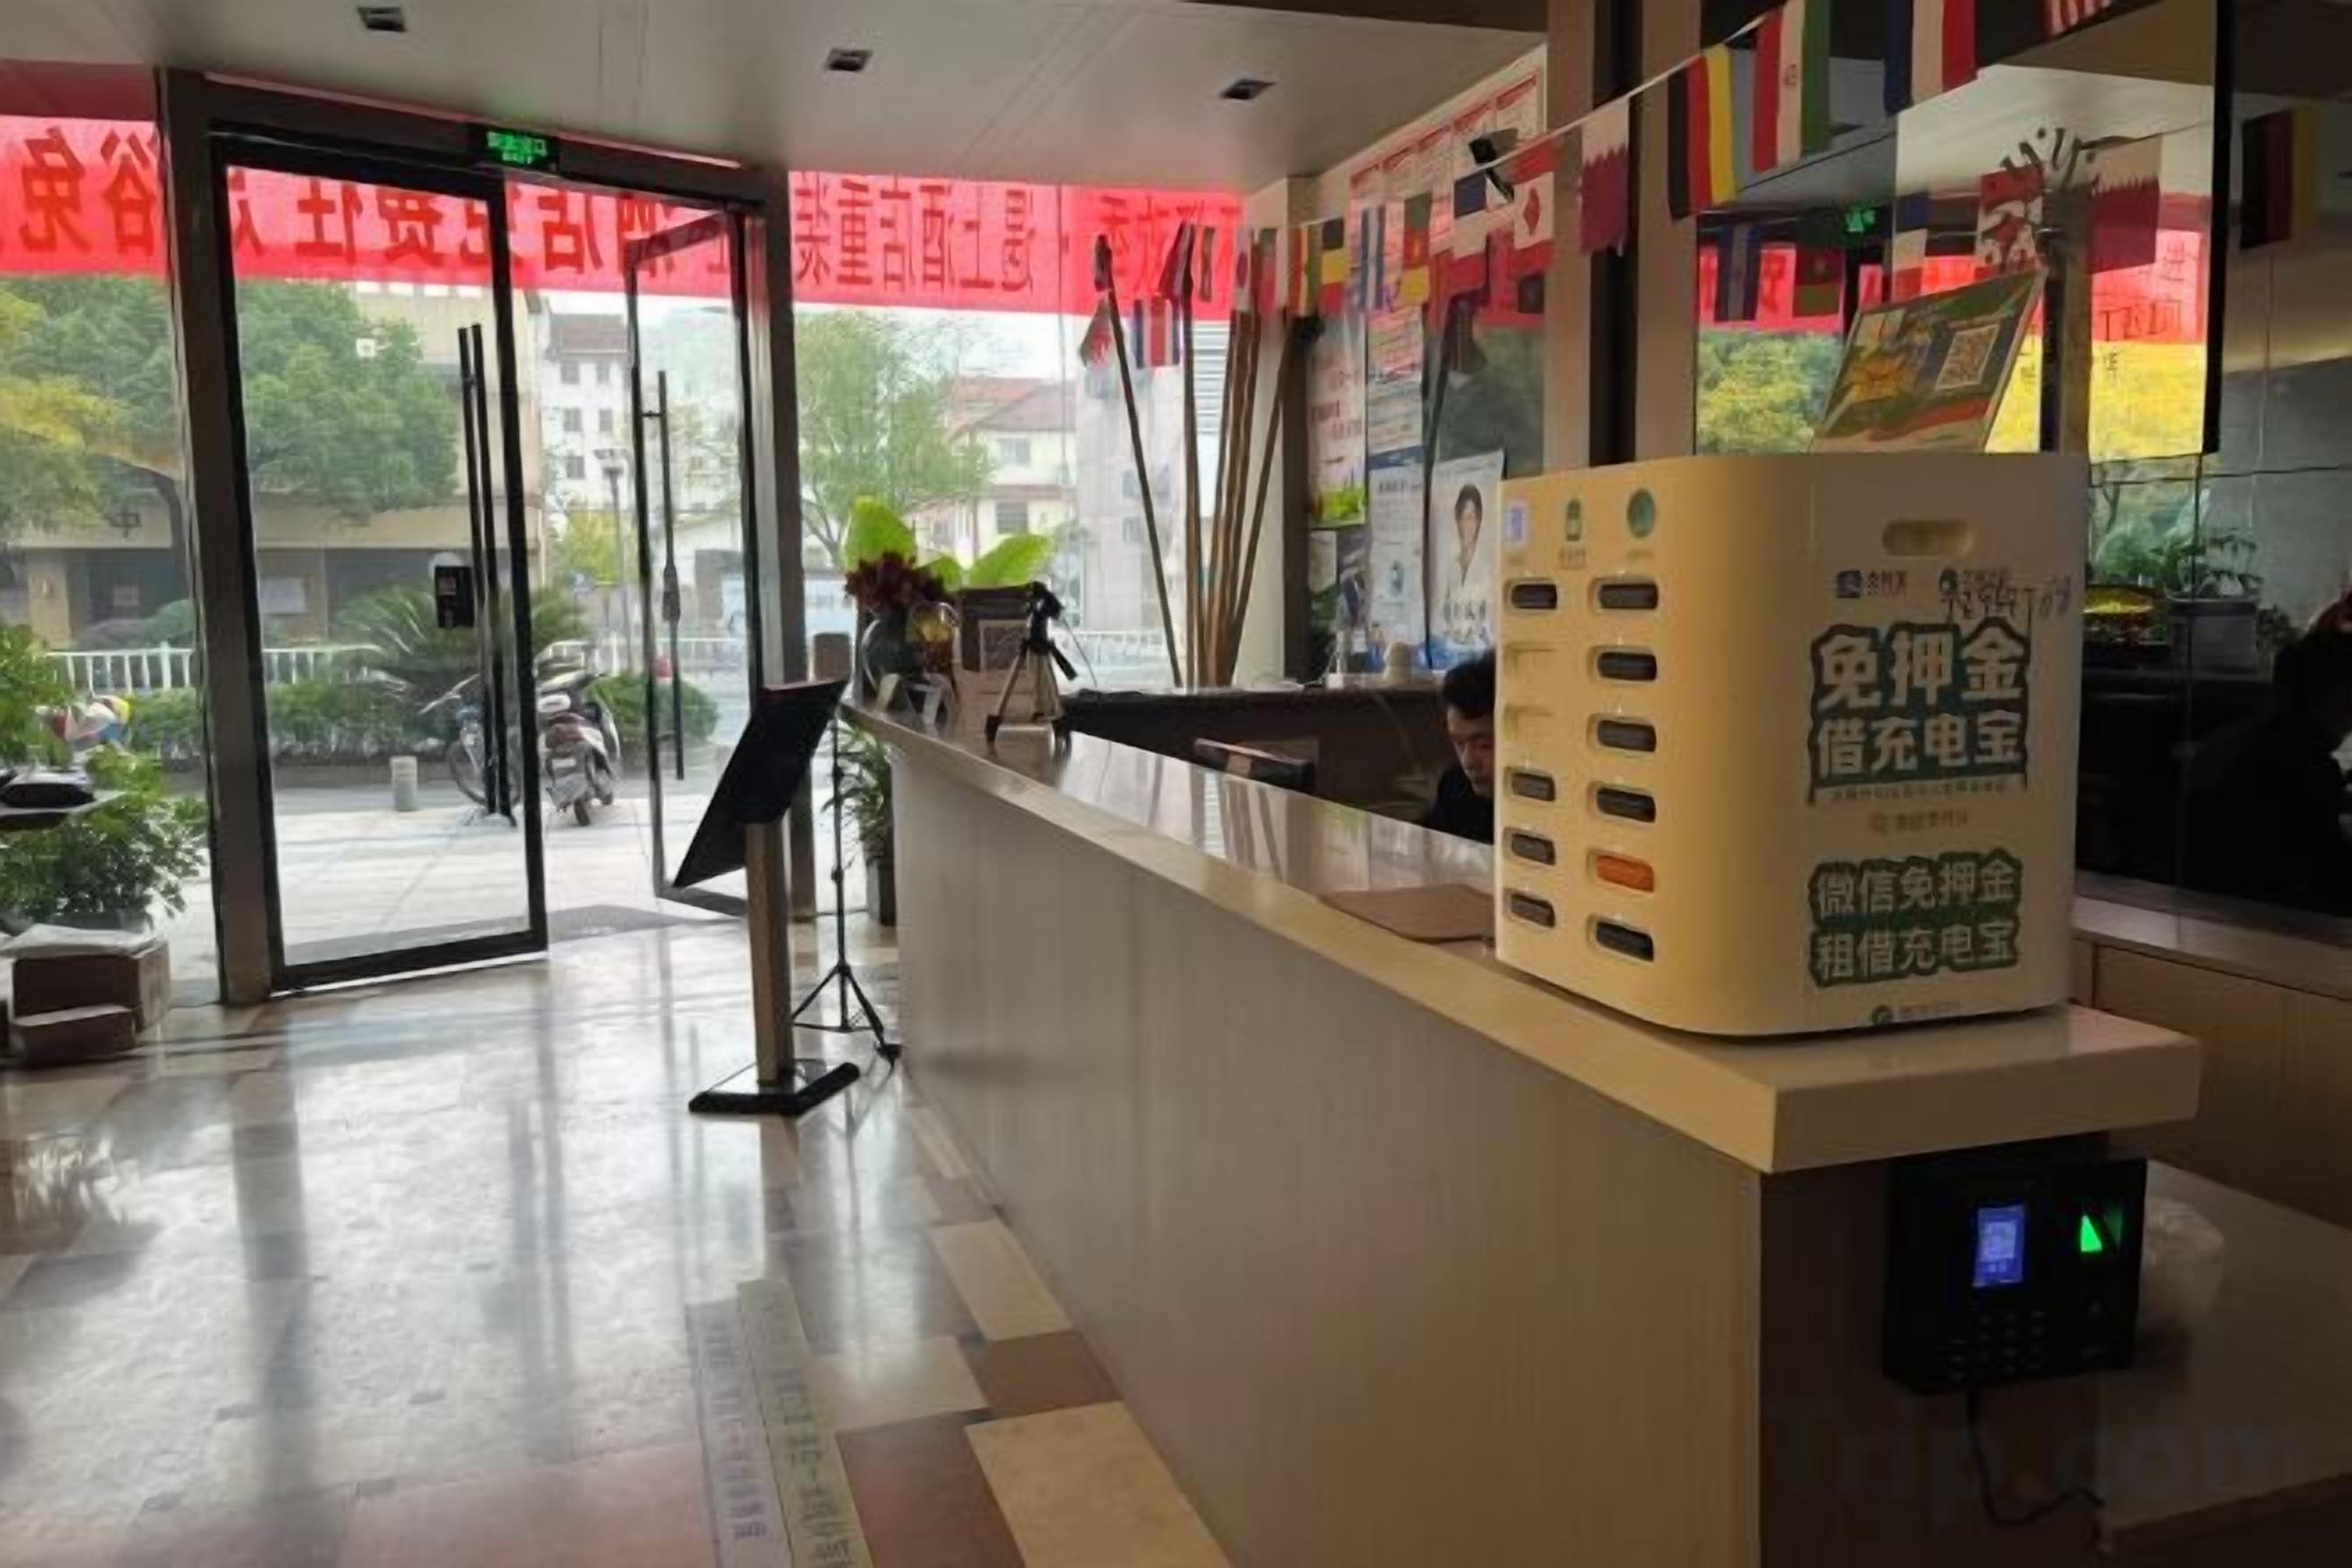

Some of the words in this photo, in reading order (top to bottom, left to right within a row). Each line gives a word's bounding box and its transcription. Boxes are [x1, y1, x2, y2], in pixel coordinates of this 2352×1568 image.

[1816, 625, 2025, 710] 免押金
[1816, 710, 2022, 780] 借充电宝
[1815, 857, 2017, 919] 微信免押金
[1815, 919, 2016, 982] 租借充电宝
